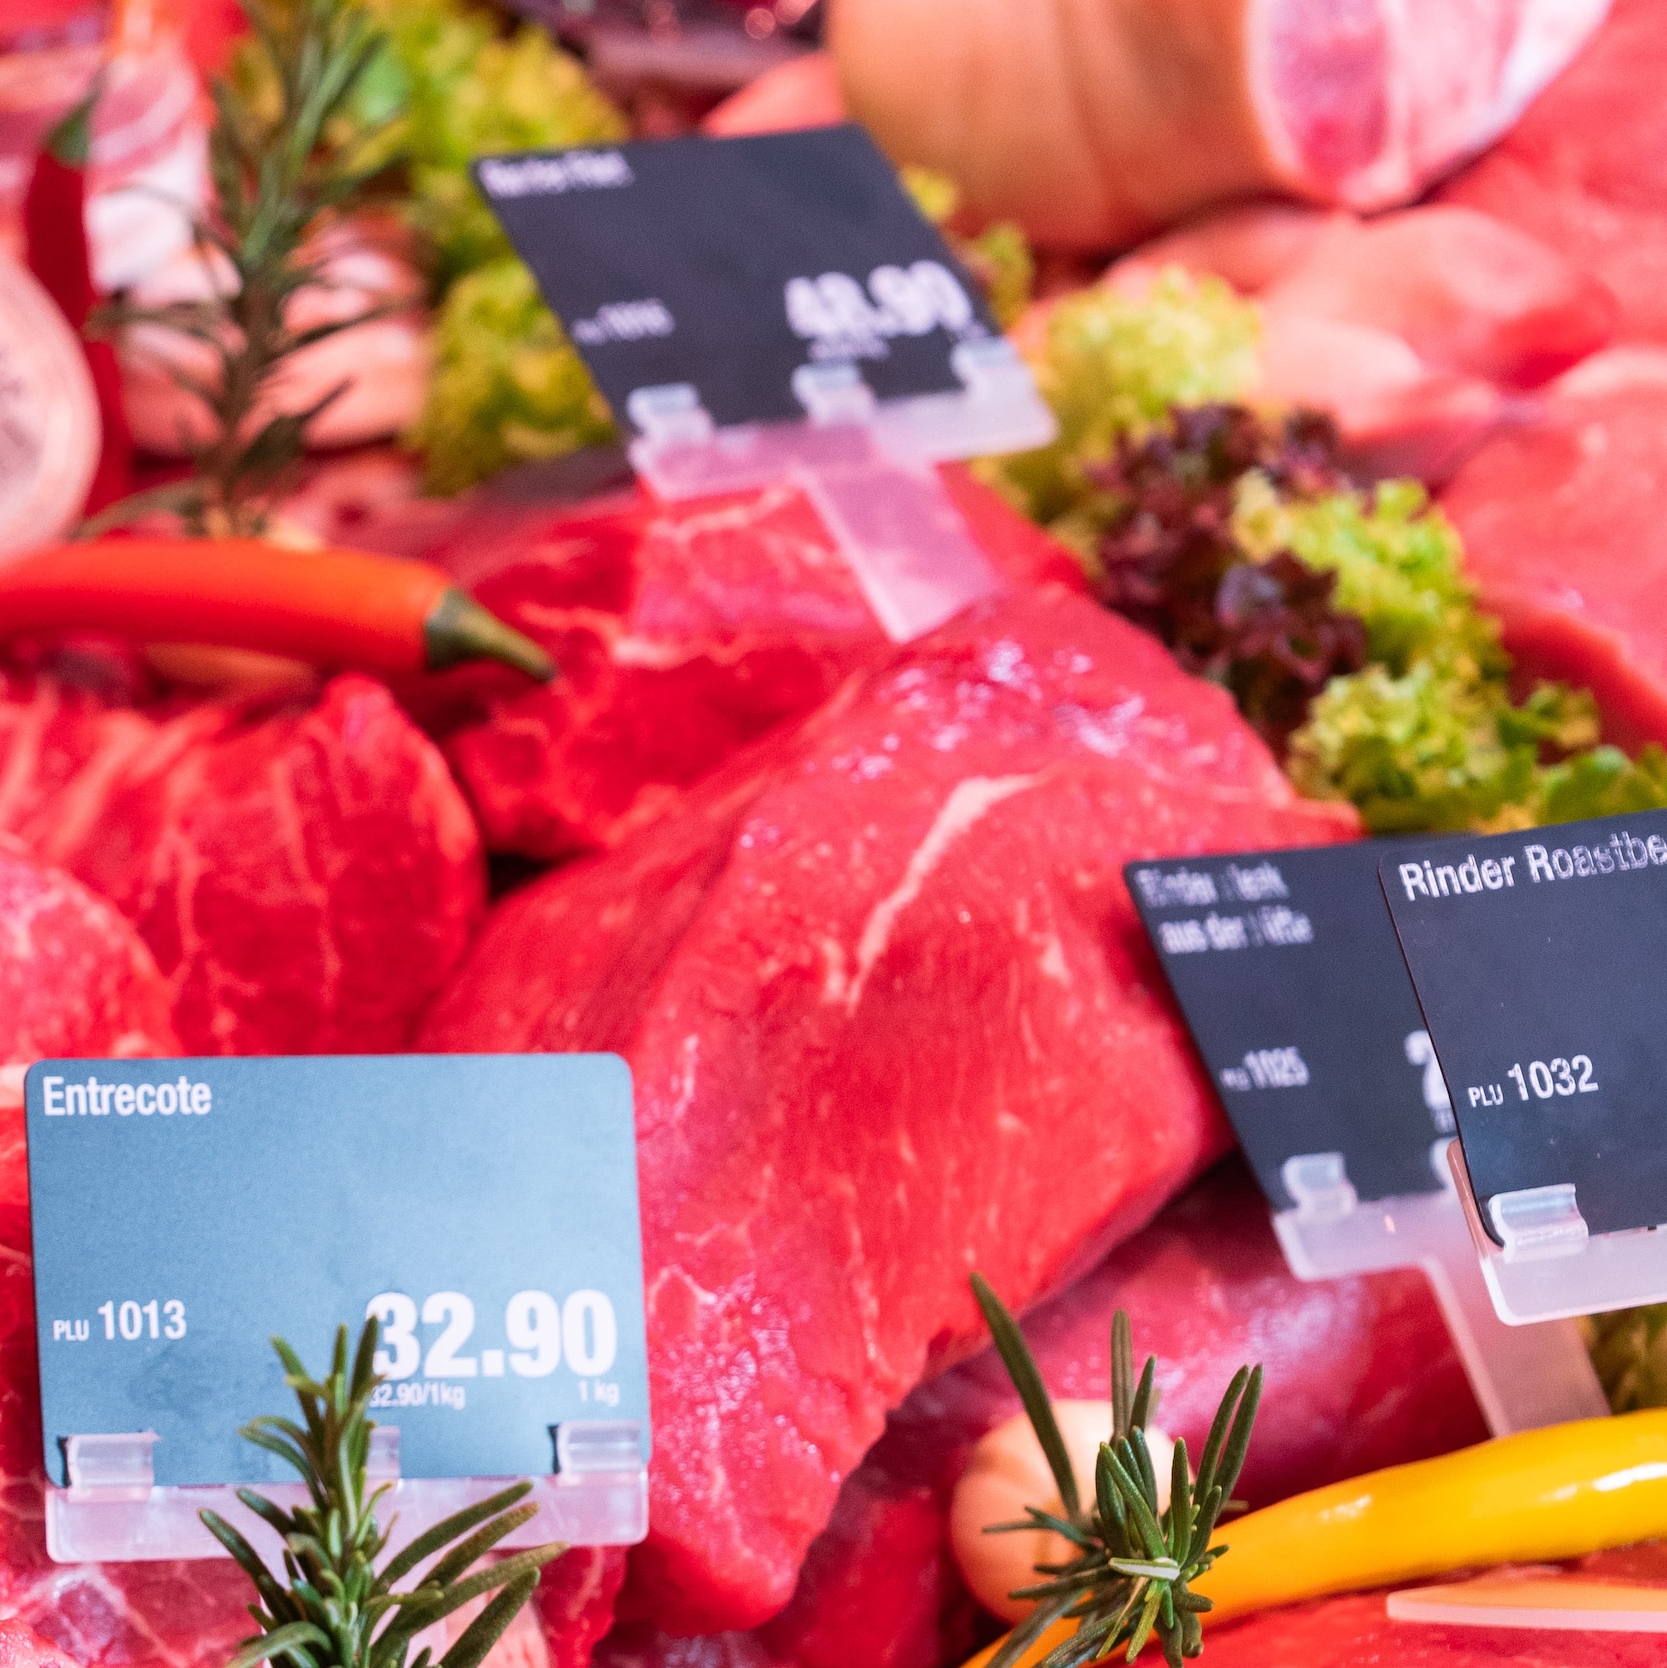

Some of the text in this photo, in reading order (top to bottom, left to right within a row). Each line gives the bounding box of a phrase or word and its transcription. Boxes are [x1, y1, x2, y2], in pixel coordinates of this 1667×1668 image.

[1398, 854, 1516, 901] Rinder
[43, 1075, 212, 1116] Entrecote
[1468, 1053, 1599, 1108] PLU 1032
[53, 1299, 187, 1341] PLU 1013
[366, 1288, 617, 1380] 32.90
[578, 1381, 620, 1407] 1 kg
